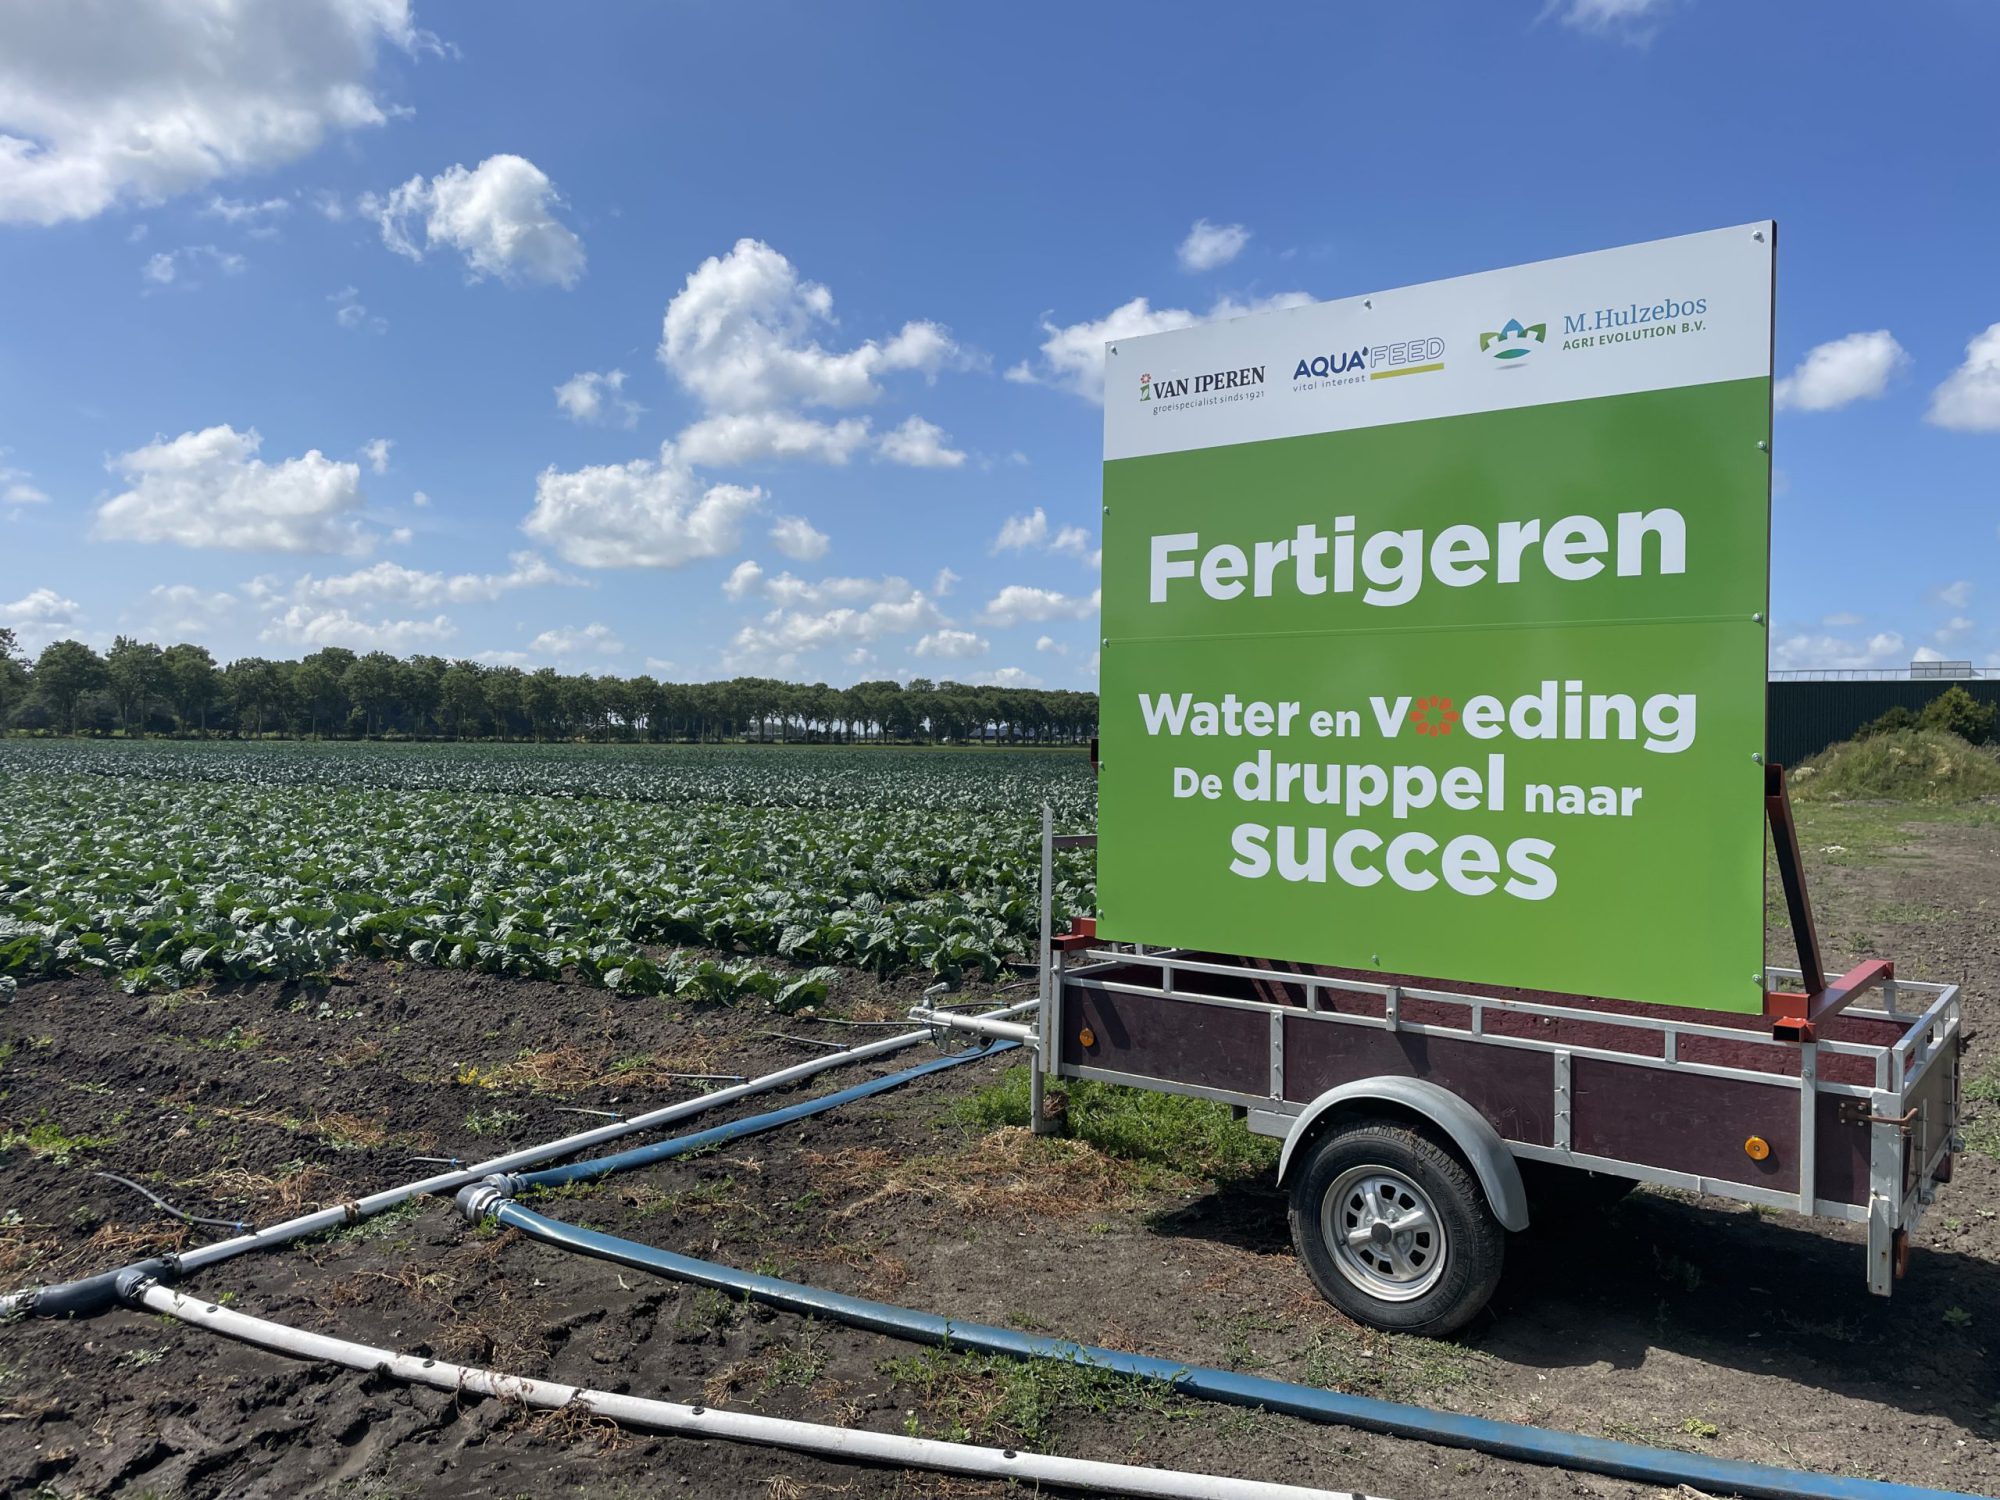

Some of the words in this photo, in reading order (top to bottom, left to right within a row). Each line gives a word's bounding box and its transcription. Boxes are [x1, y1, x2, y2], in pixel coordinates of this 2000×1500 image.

[1562, 337, 1595, 351] AGRI
[1599, 324, 1677, 346] EVOLUTION
[1681, 320, 1706, 334] B.V.
[1153, 378, 1189, 400] VAN
[1194, 365, 1266, 394] IPEREN
[1292, 381, 1318, 392] vital
[1321, 374, 1366, 389] interest
[1152, 396, 1218, 416] groeispecialist
[1219, 392, 1244, 405] sinds
[1245, 390, 1265, 401] 1921
[1149, 508, 1687, 607] Fertigeren
[1138, 693, 1300, 737] Water
[1309, 710, 1361, 738] en
[1173, 767, 1223, 800] De
[1232, 749, 1505, 819] druppel
[1525, 783, 1643, 817] naar
[1229, 822, 1558, 901] succes
